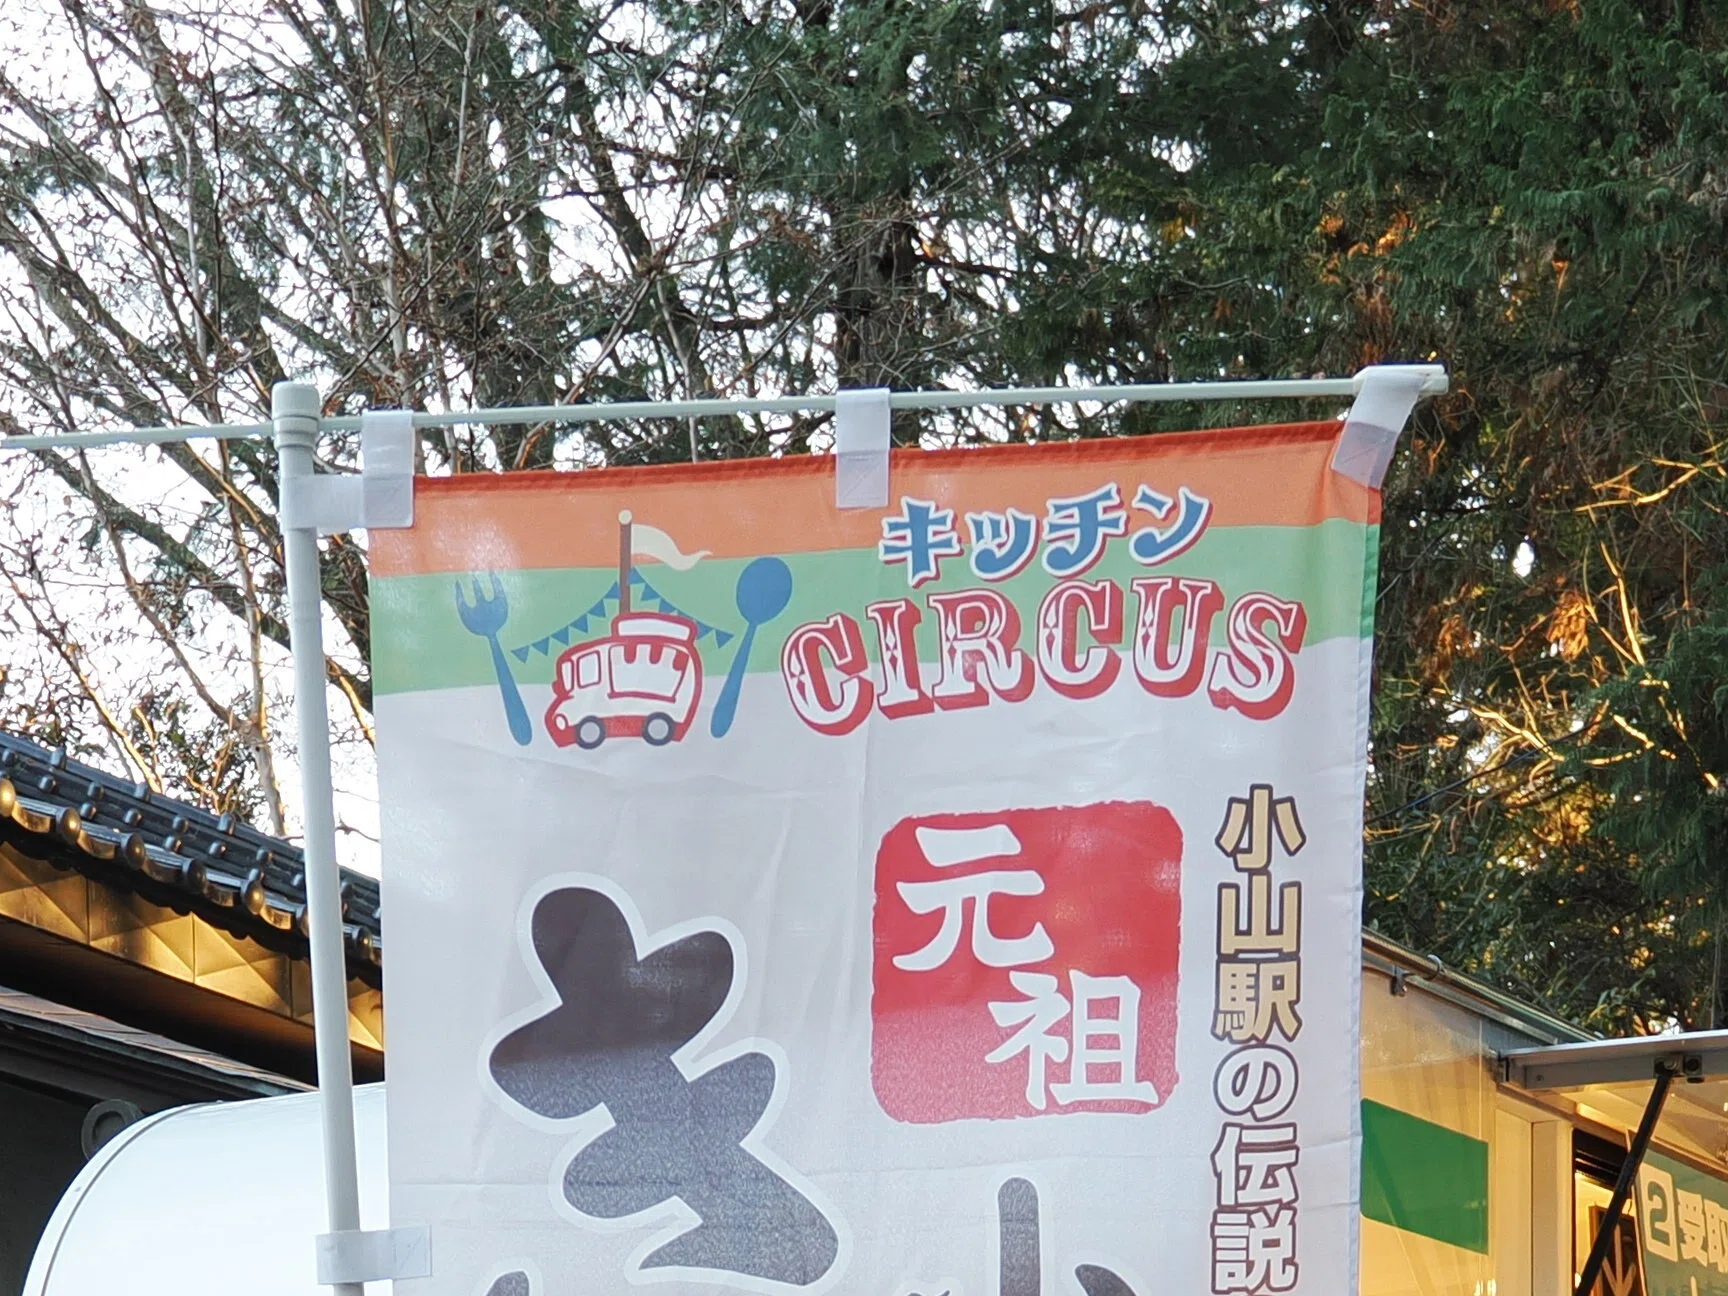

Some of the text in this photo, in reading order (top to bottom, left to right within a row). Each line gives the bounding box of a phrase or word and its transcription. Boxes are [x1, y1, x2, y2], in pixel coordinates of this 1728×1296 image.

[881, 484, 1210, 587] キッチン
[780, 577, 1307, 735] CIRCUS
[893, 826, 1161, 1110] 元祖
